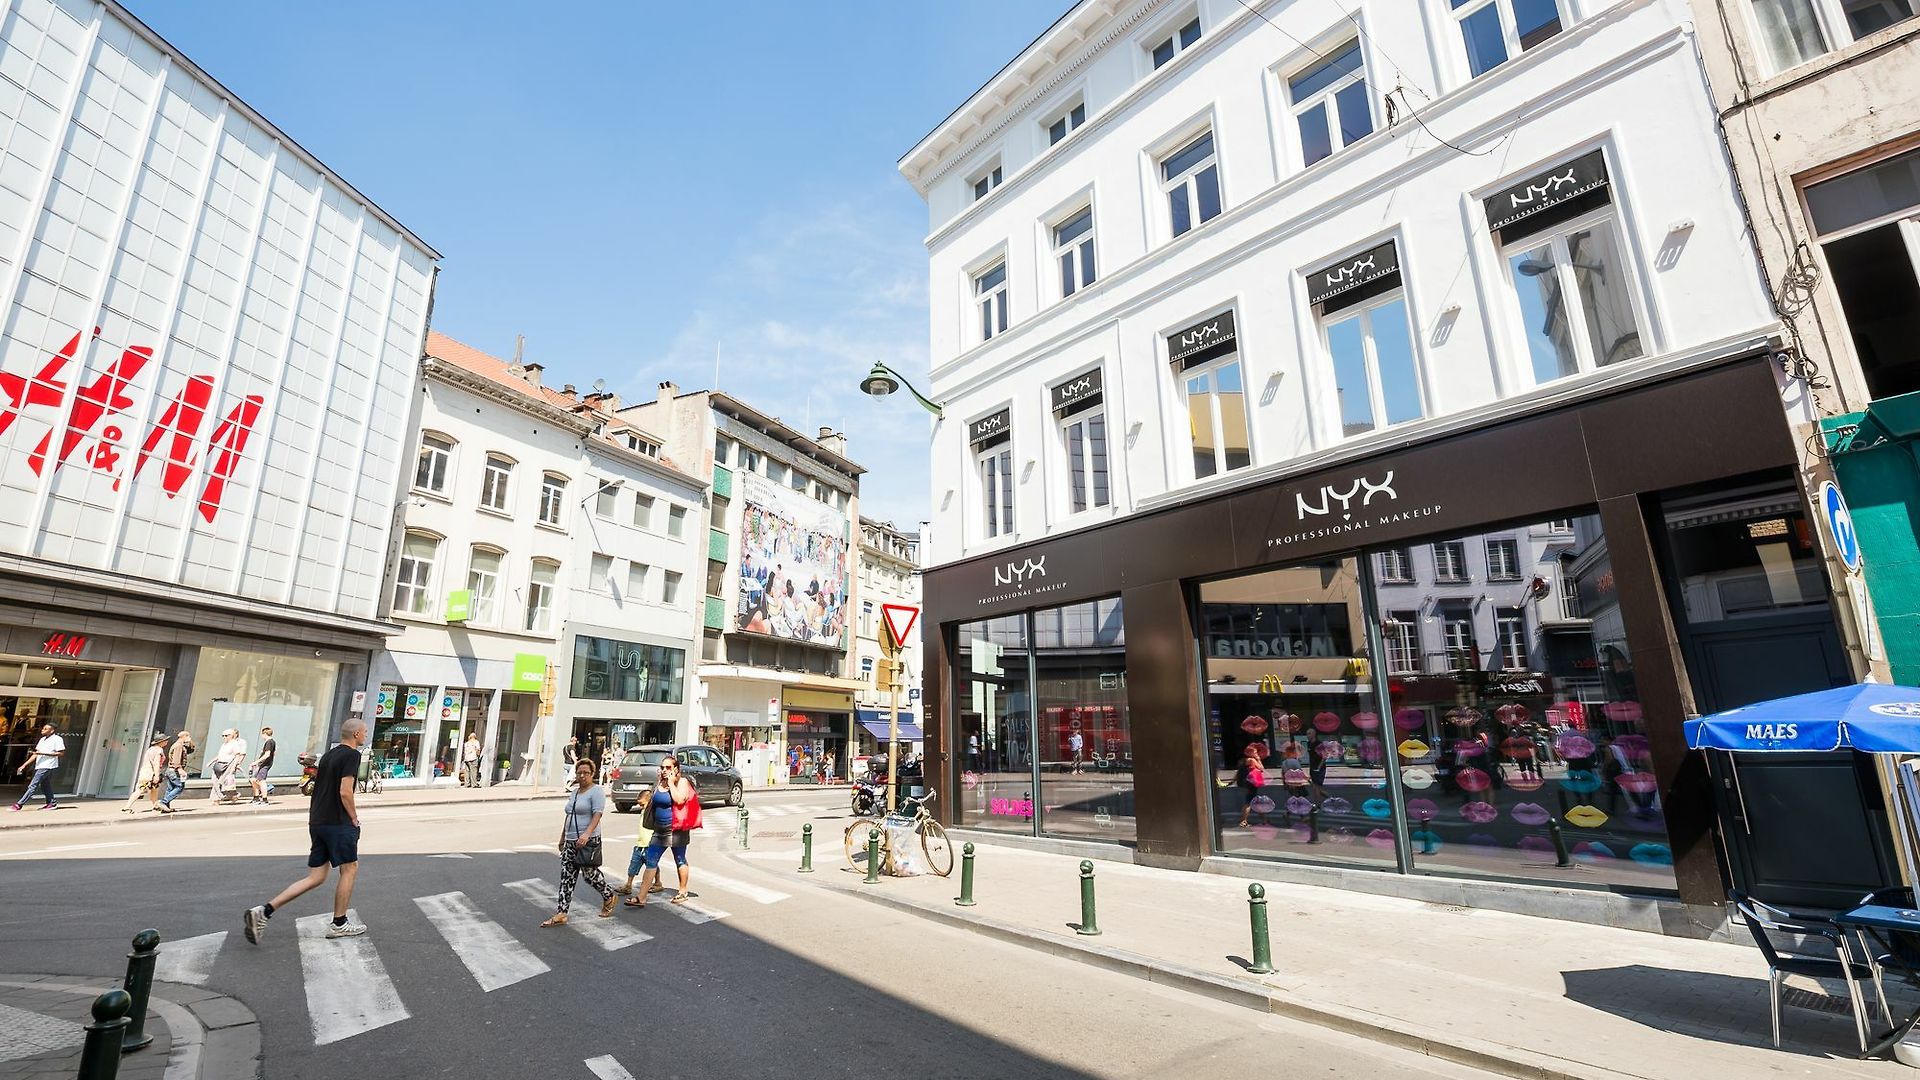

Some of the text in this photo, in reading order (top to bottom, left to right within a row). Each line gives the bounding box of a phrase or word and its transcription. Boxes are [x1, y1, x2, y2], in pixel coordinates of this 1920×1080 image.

[1493, 179, 1604, 228] PROFESSIONAL MAKEUP
[1510, 168, 1576, 208] NYX
[1312, 265, 1396, 302] PROFESSIONAL MAKEUP
[1326, 255, 1375, 287] NYX
[1182, 321, 1218, 347] NYX
[1061, 376, 1090, 399] NYX
[977, 415, 1001, 434] NYX
[1295, 470, 1397, 520] NYX
[1267, 504, 1443, 547] PROFESSIONAL MAKEUP
[994, 555, 1046, 587] NYX
[978, 582, 1067, 605] PROFESSIONAL MAKEUP
[1745, 723, 1799, 741] MAES
[991, 798, 1034, 818] SOLDES
